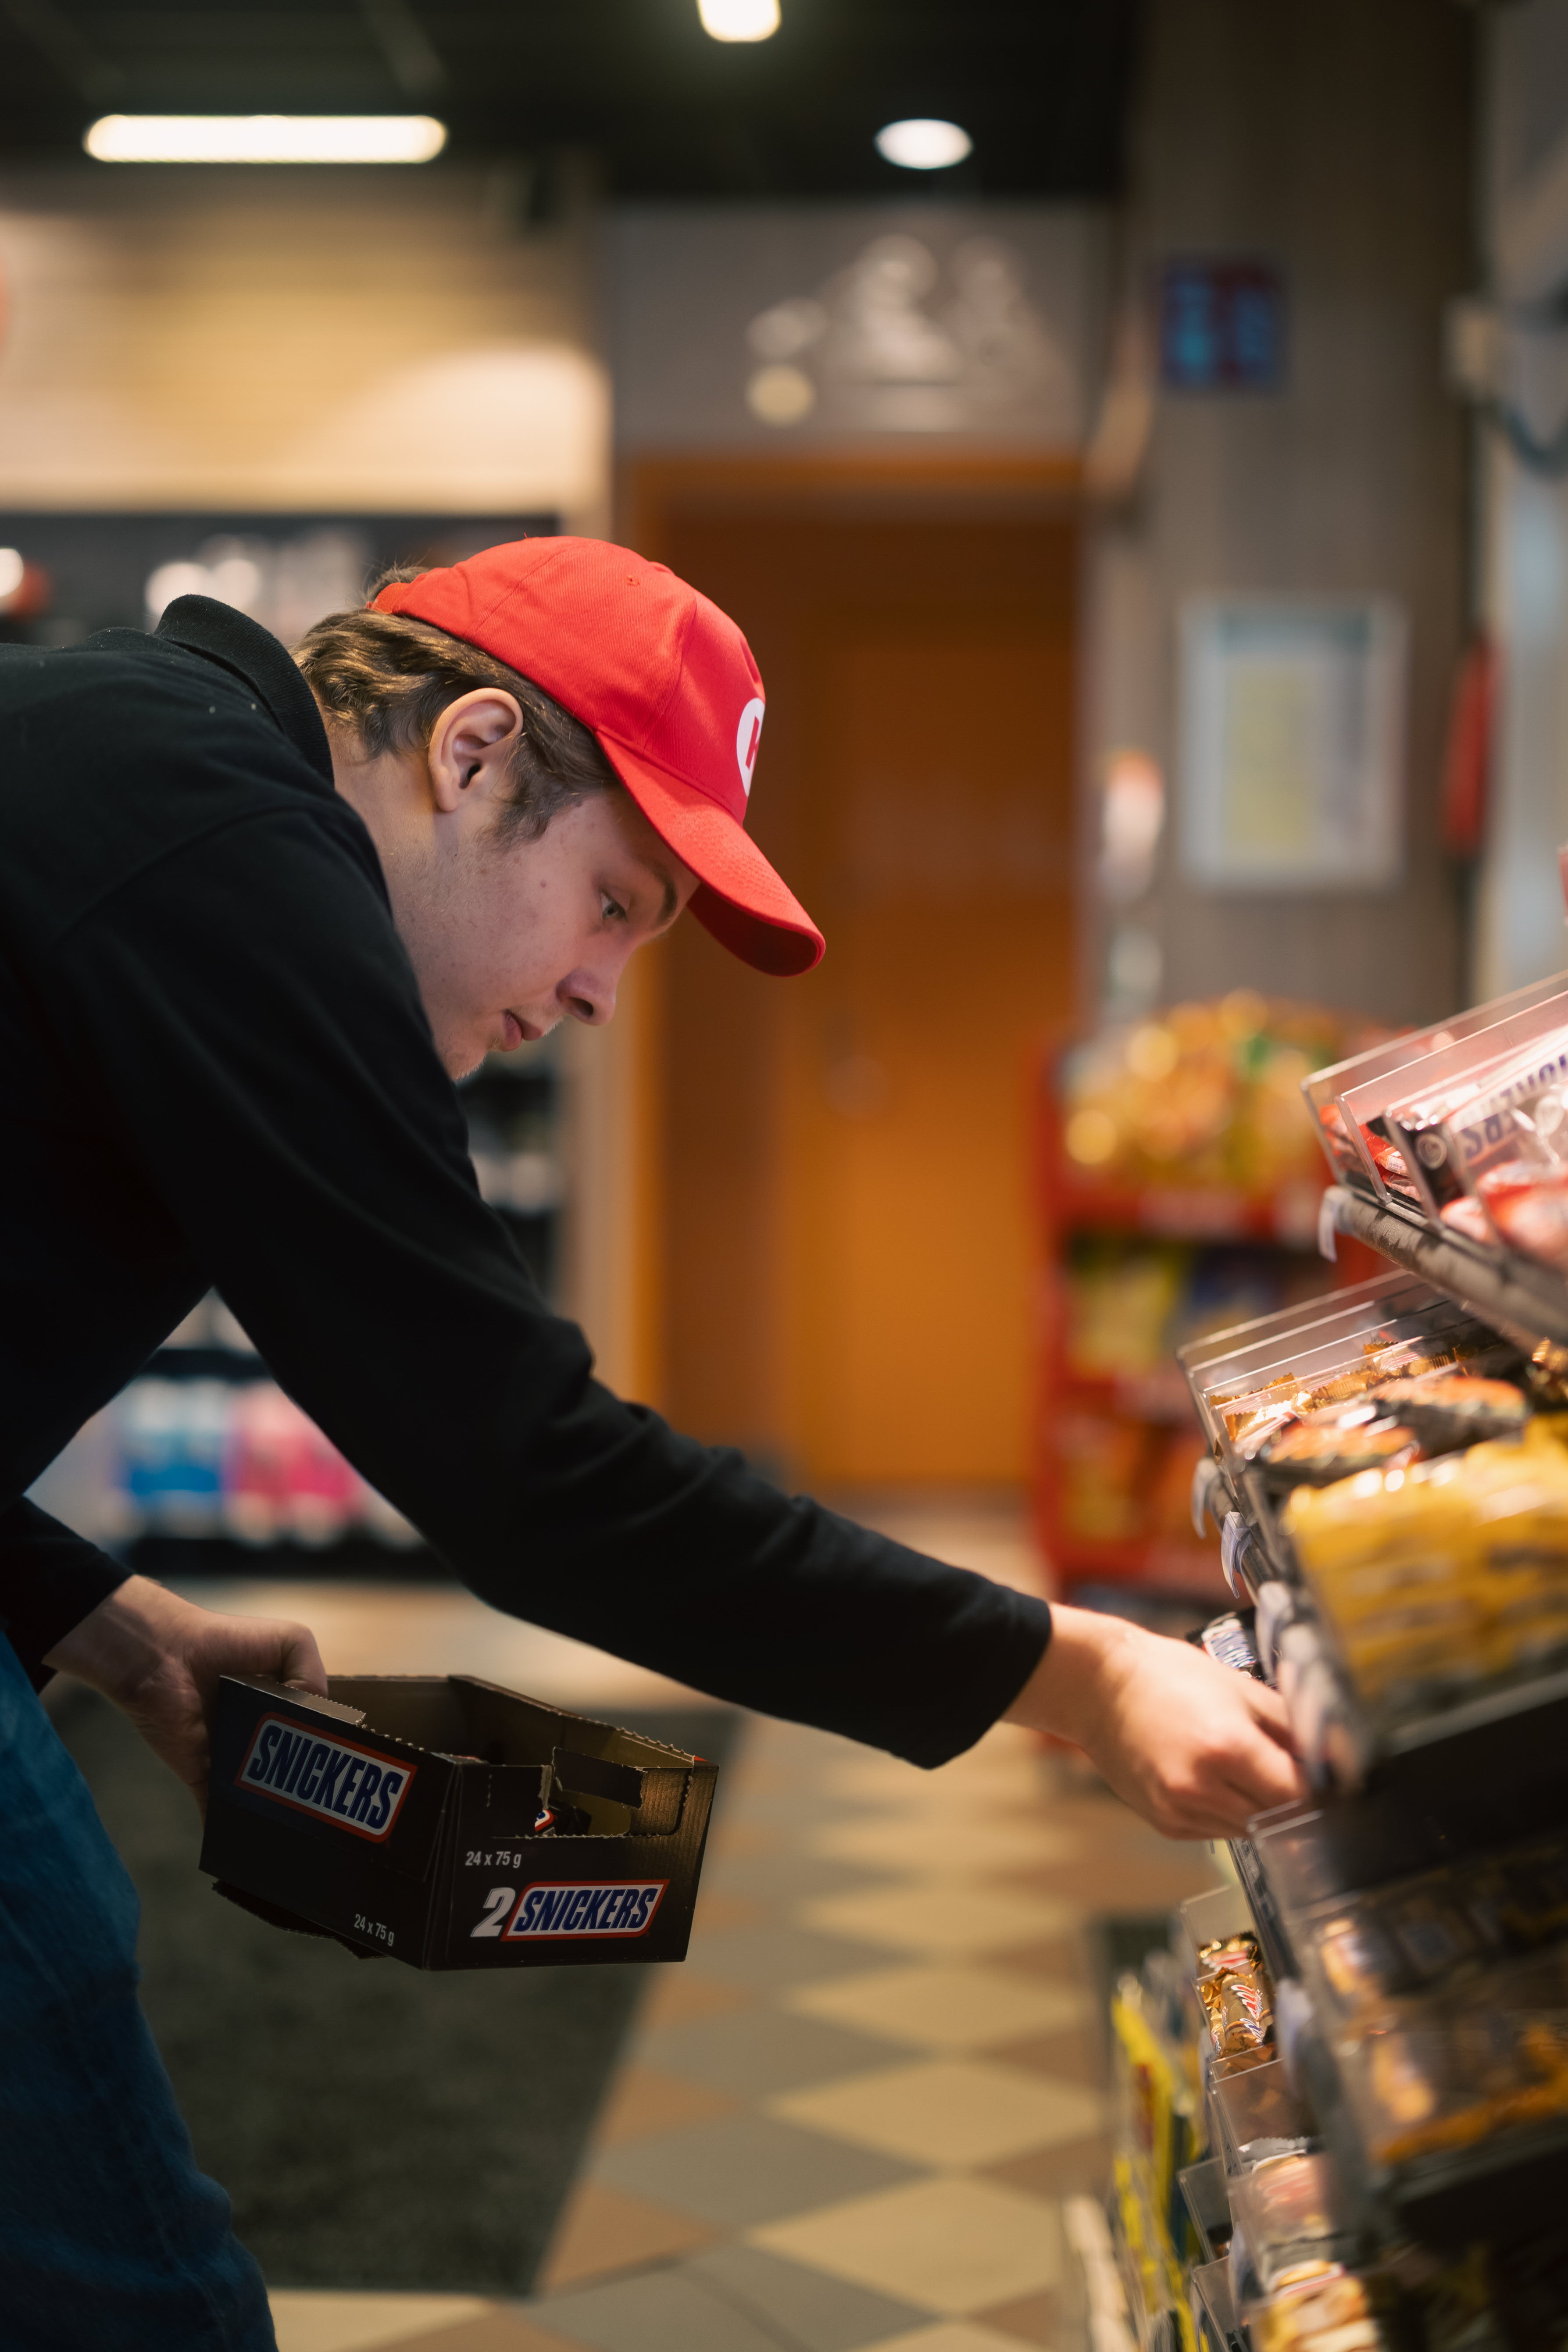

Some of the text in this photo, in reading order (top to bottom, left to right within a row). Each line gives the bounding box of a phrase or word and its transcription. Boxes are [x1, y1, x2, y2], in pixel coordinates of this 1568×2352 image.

[246, 1724, 404, 1829] SNICKERS
[465, 1851, 522, 1868] 24 x 75 g
[354, 1913, 395, 1947] 24 x 75 g
[470, 1887, 659, 1938] 2 SNICKERS
